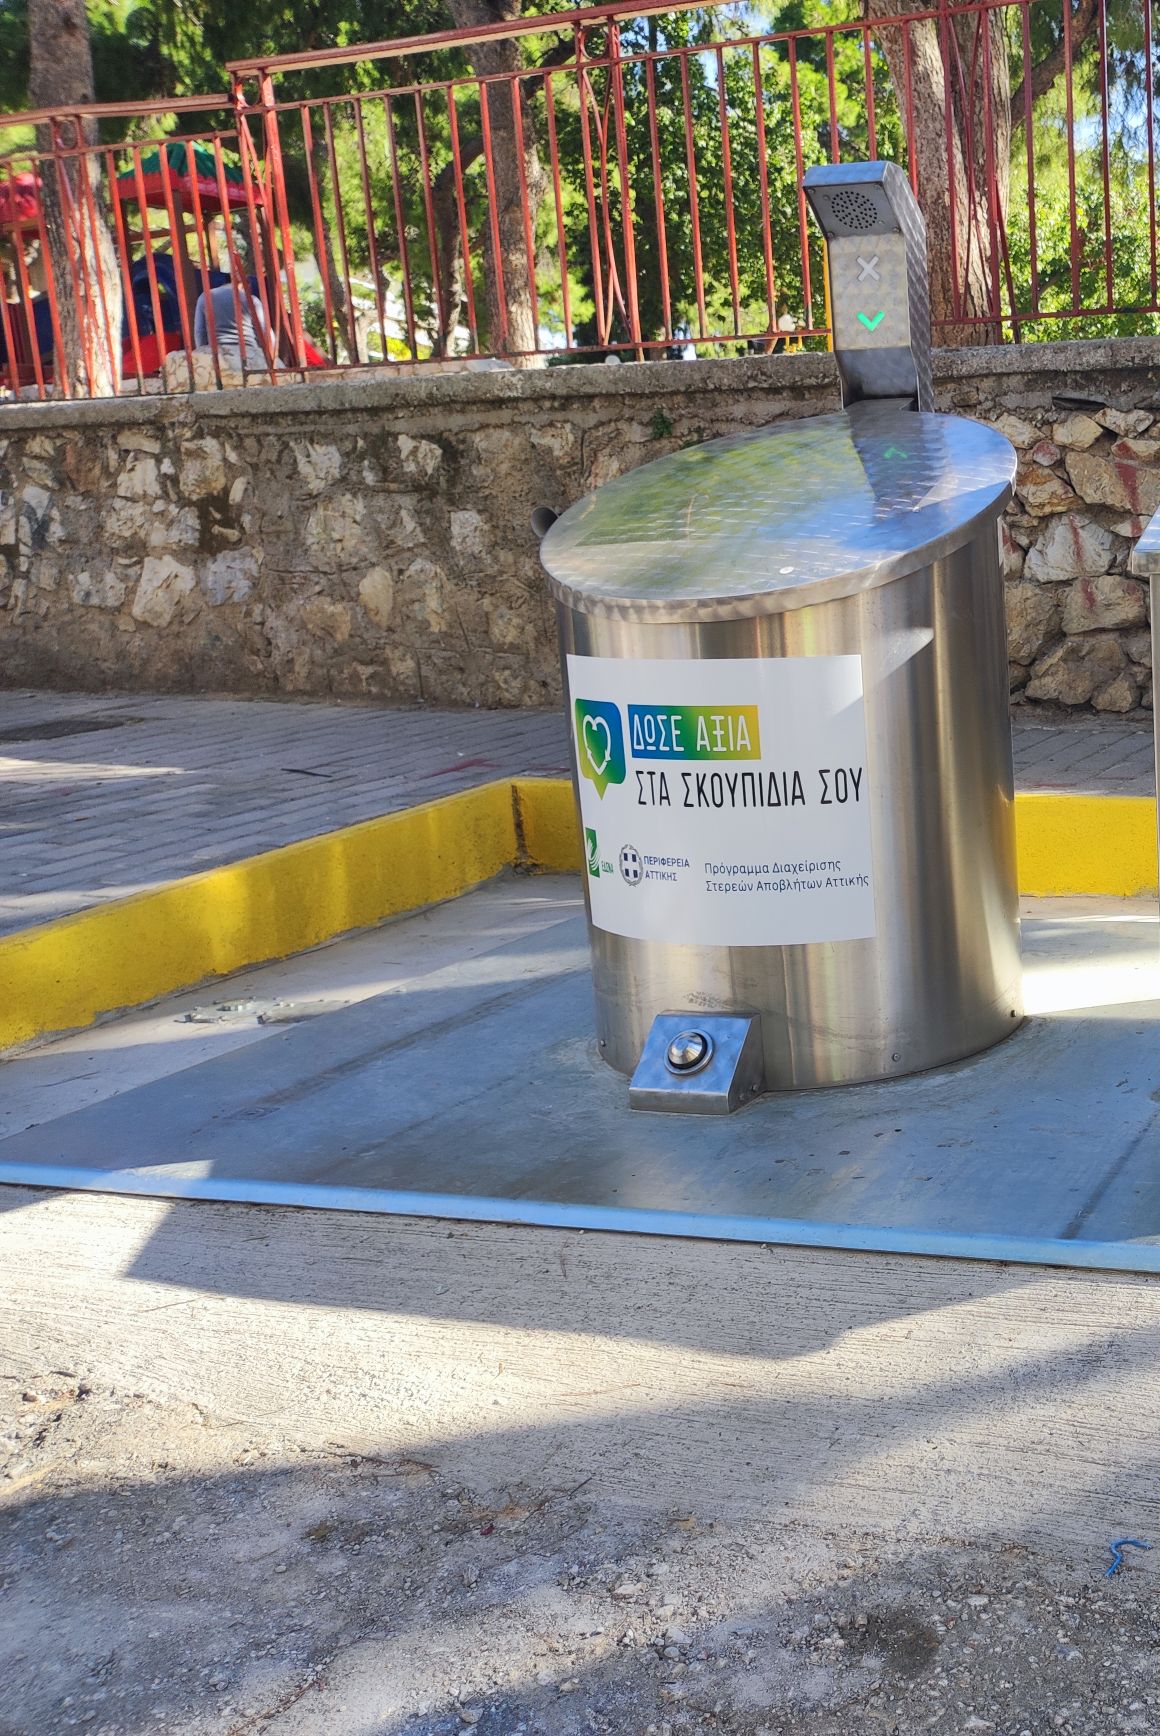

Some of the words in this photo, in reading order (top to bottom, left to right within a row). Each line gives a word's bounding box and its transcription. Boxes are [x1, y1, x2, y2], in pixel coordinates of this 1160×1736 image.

[633, 714, 684, 751] ΔΩΣΕ
[697, 715, 751, 752] ΑΞΙΑ
[637, 770, 671, 806] ΣΤΑ
[683, 770, 806, 808] ΣΚΟΥΠΙΔΙΑ
[819, 767, 862, 804] ΣΟΥ
[644, 856, 690, 867] ΠΕΡΙΦΕΡΕΙΑ
[705, 862, 769, 876] Πρόγραμμα
[772, 860, 841, 875] Διαχείρισης
[645, 871, 677, 881] ΑΤΤΙΚΗΣ
[706, 880, 753, 893] Στερεών
[756, 878, 822, 892] Αποβλήτων
[825, 874, 869, 888] Αττικής
